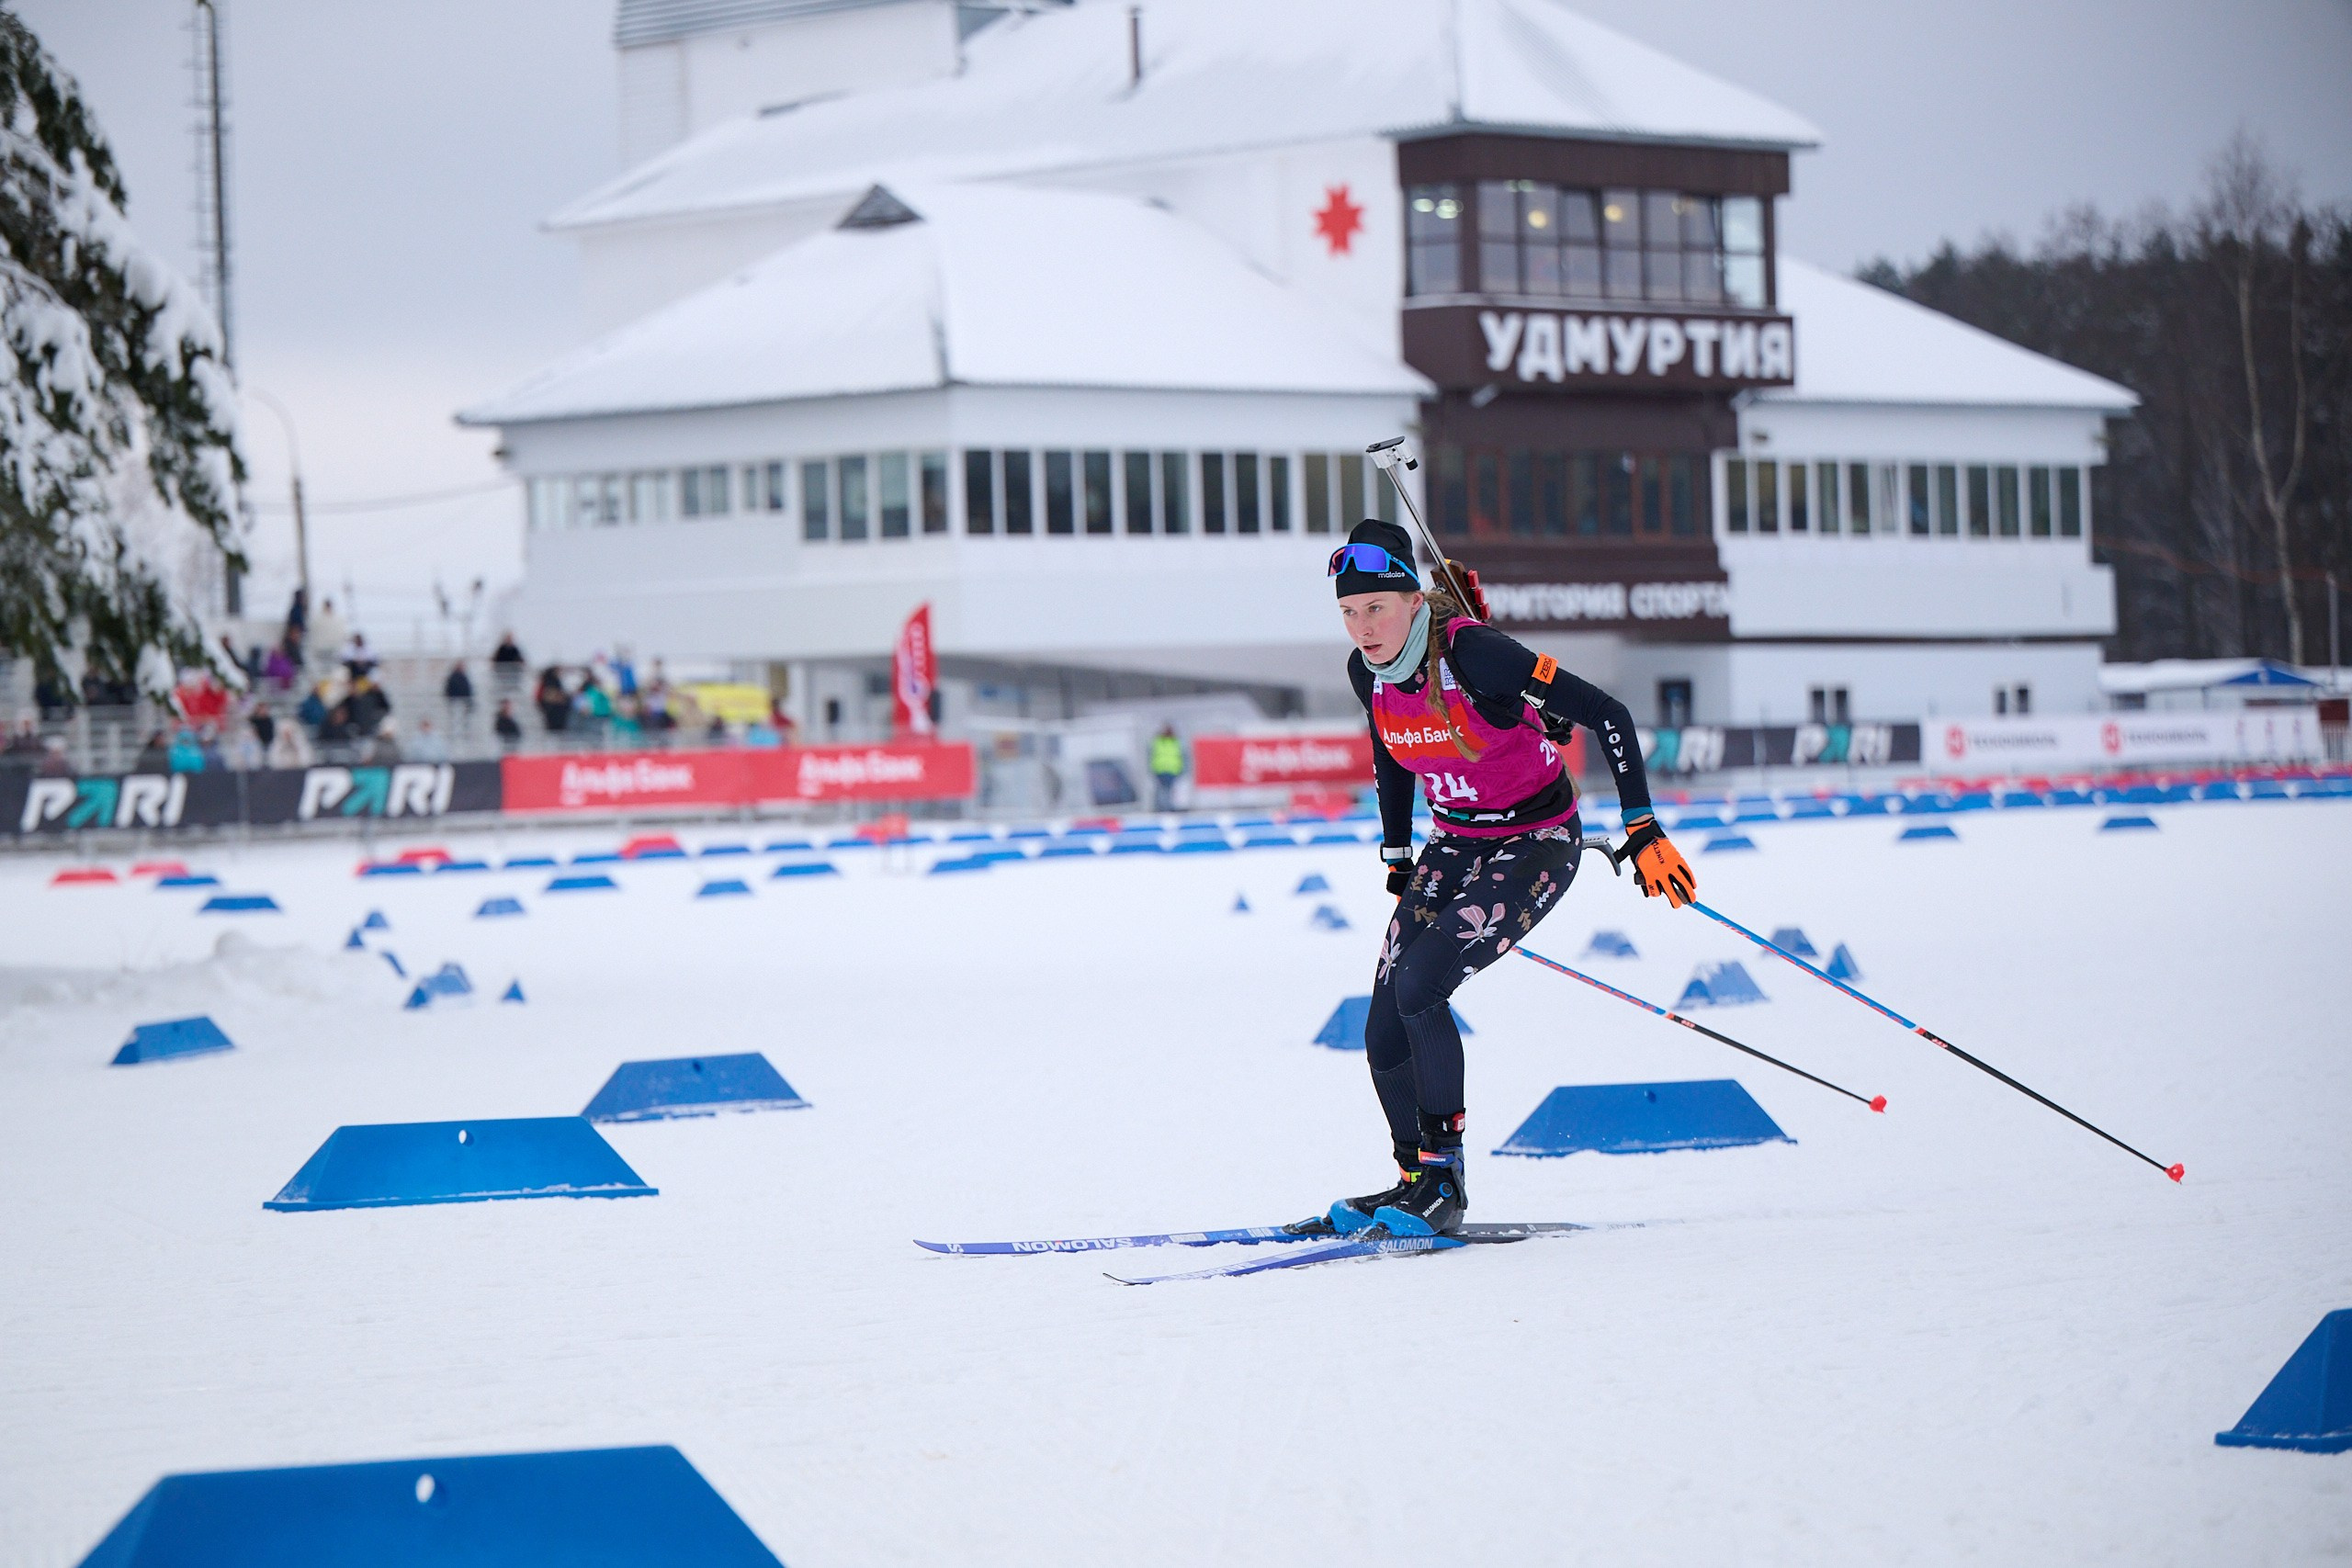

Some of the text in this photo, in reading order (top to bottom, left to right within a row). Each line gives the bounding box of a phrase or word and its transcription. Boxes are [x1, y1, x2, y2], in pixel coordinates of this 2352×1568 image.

[1478, 310, 1793, 383] УДМУРТИЯ
[1383, 727, 1423, 749] Альфа
[1603, 719, 1628, 773] LOVE
[19, 773, 187, 831] PARI
[297, 761, 457, 820] PARI
[1423, 773, 1478, 802] 24
[1422, 1196, 1444, 1218] SALOMON
[1012, 1237, 1132, 1251] SALOMON
[1378, 1238, 1433, 1254] SALOMON
